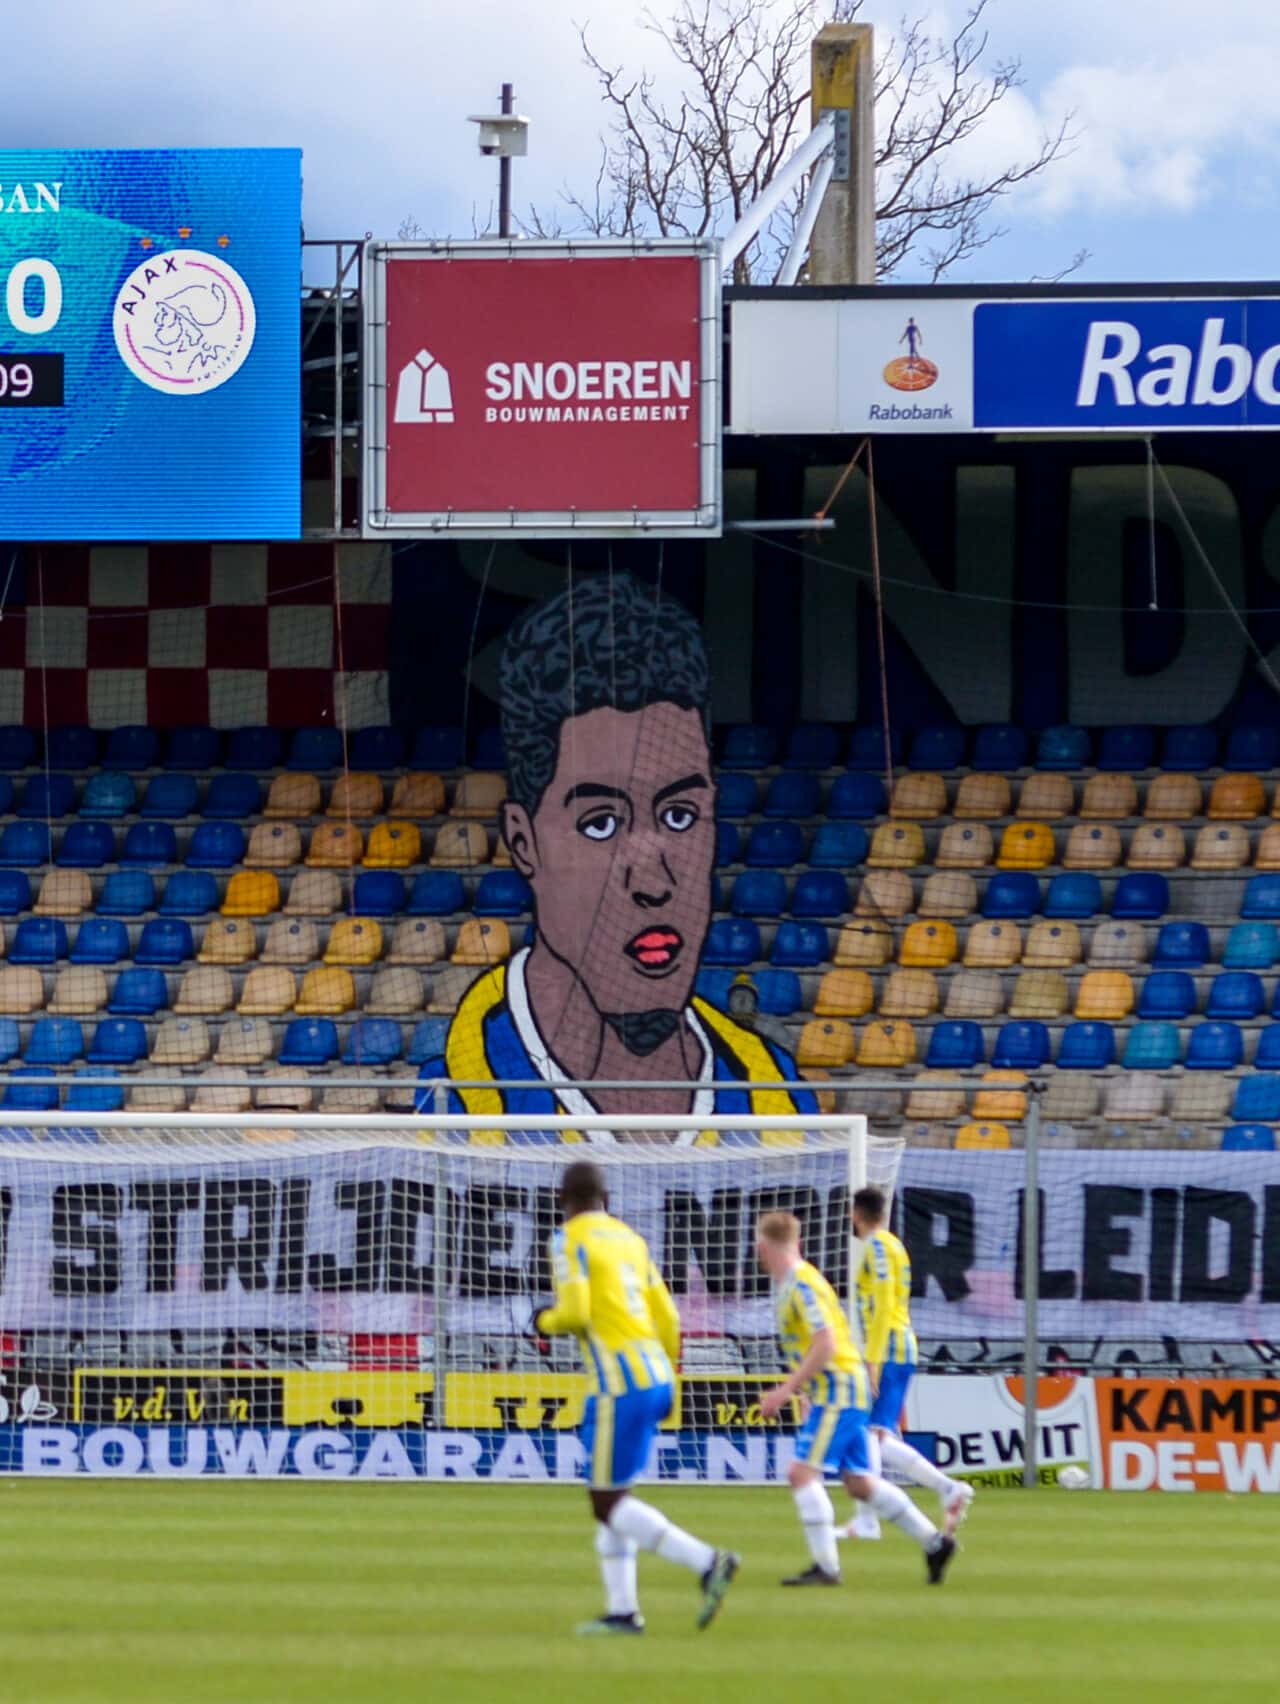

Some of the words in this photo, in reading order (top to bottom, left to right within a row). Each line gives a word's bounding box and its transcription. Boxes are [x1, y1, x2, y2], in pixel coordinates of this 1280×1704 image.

[121, 256, 179, 317] AJAX
[485, 360, 692, 401] SNOEREN
[485, 405, 691, 423] BOUWMANAGEMENT
[869, 403, 954, 421] Rabobank
[52, 1177, 570, 1298] STRIJDE
[1013, 1183, 1280, 1304] LEID
[186, 1388, 250, 1421] Vn
[934, 1432, 985, 1468] DE
